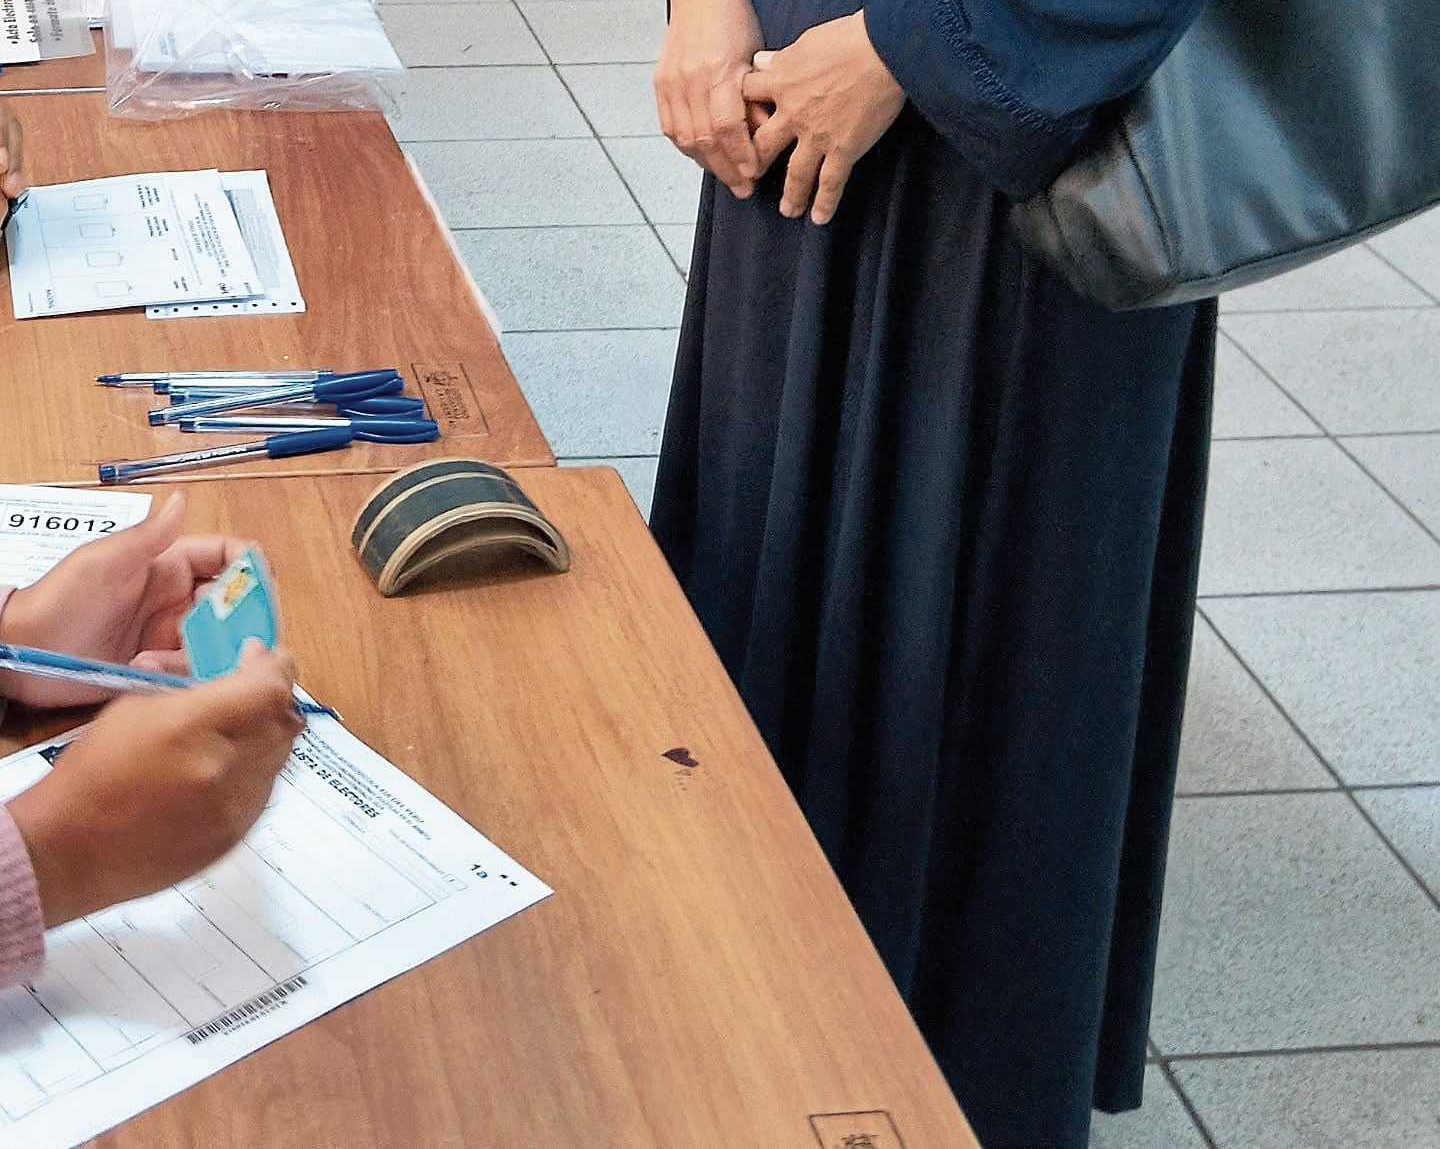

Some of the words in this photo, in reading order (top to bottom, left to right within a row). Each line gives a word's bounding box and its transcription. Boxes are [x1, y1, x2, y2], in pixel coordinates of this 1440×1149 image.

[8, 514, 116, 533] 916012
[292, 747, 318, 770] LISTA
[317, 769, 331, 781] DE
[329, 779, 381, 818] ELECTORES
